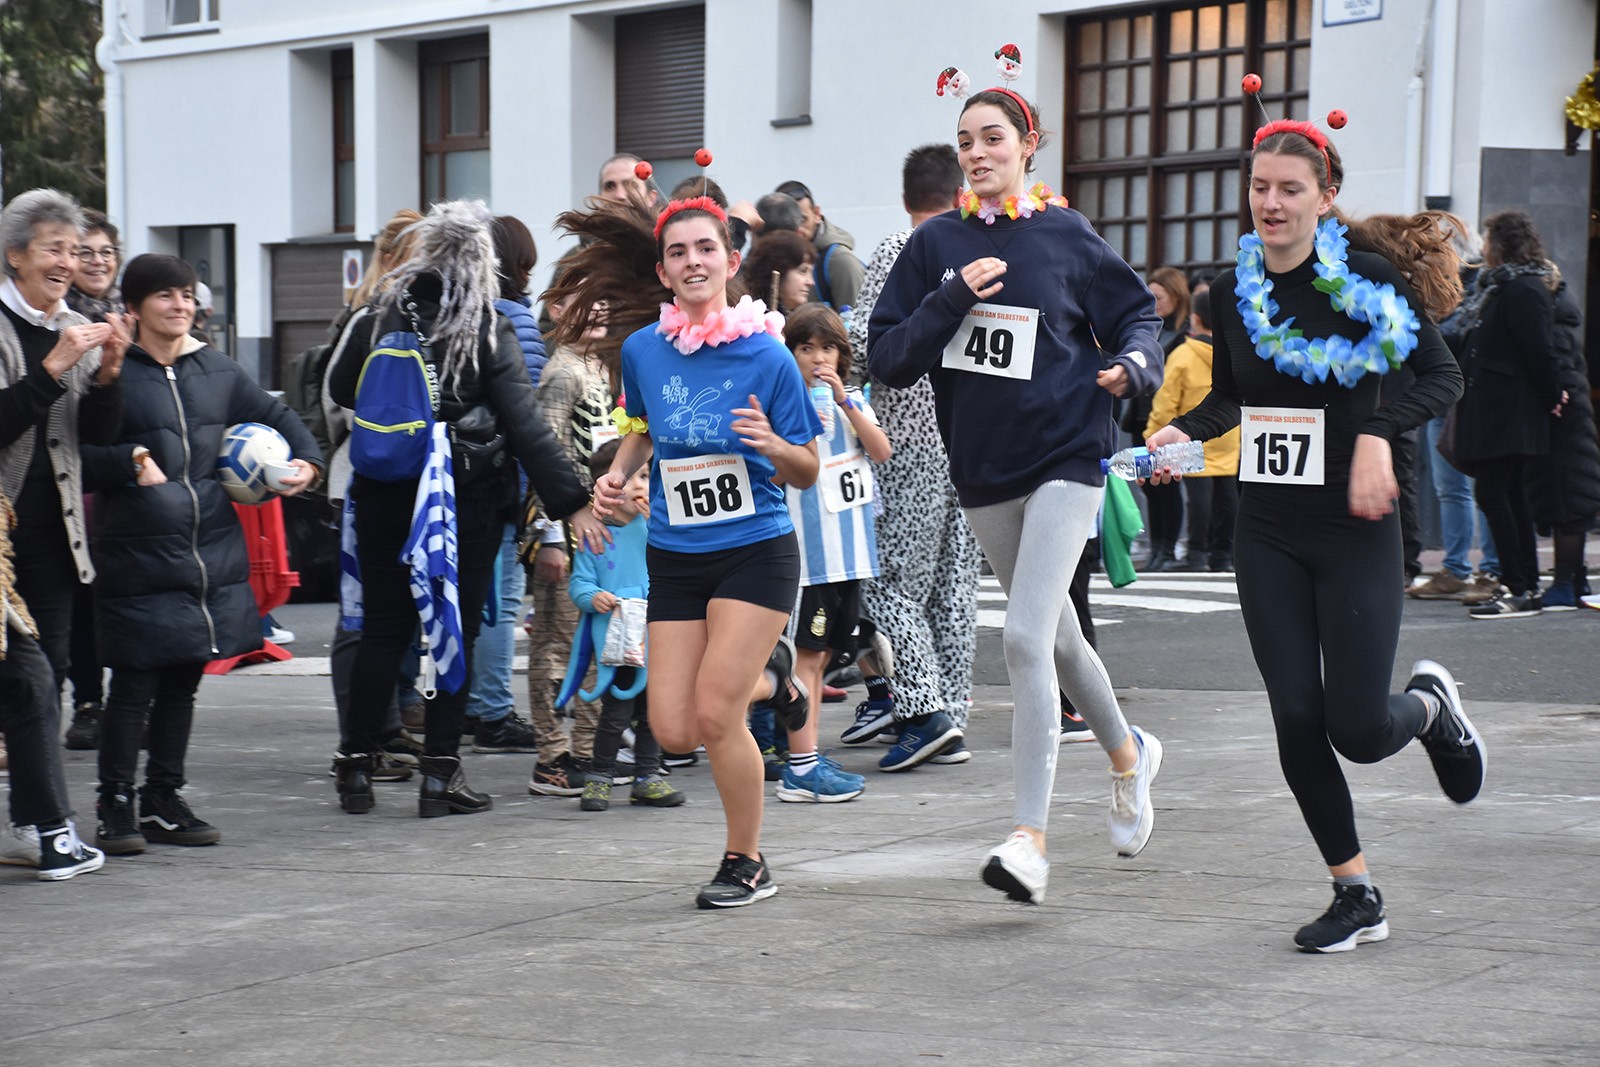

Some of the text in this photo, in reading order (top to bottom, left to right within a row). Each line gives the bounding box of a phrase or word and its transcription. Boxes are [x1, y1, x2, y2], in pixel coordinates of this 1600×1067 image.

[985, 311, 996, 319] SAN
[997, 313, 1029, 322] SILBESTREA
[964, 326, 1014, 369] 49
[694, 462, 706, 470] SAN
[1253, 432, 1311, 476] 157
[673, 473, 742, 517] 158
